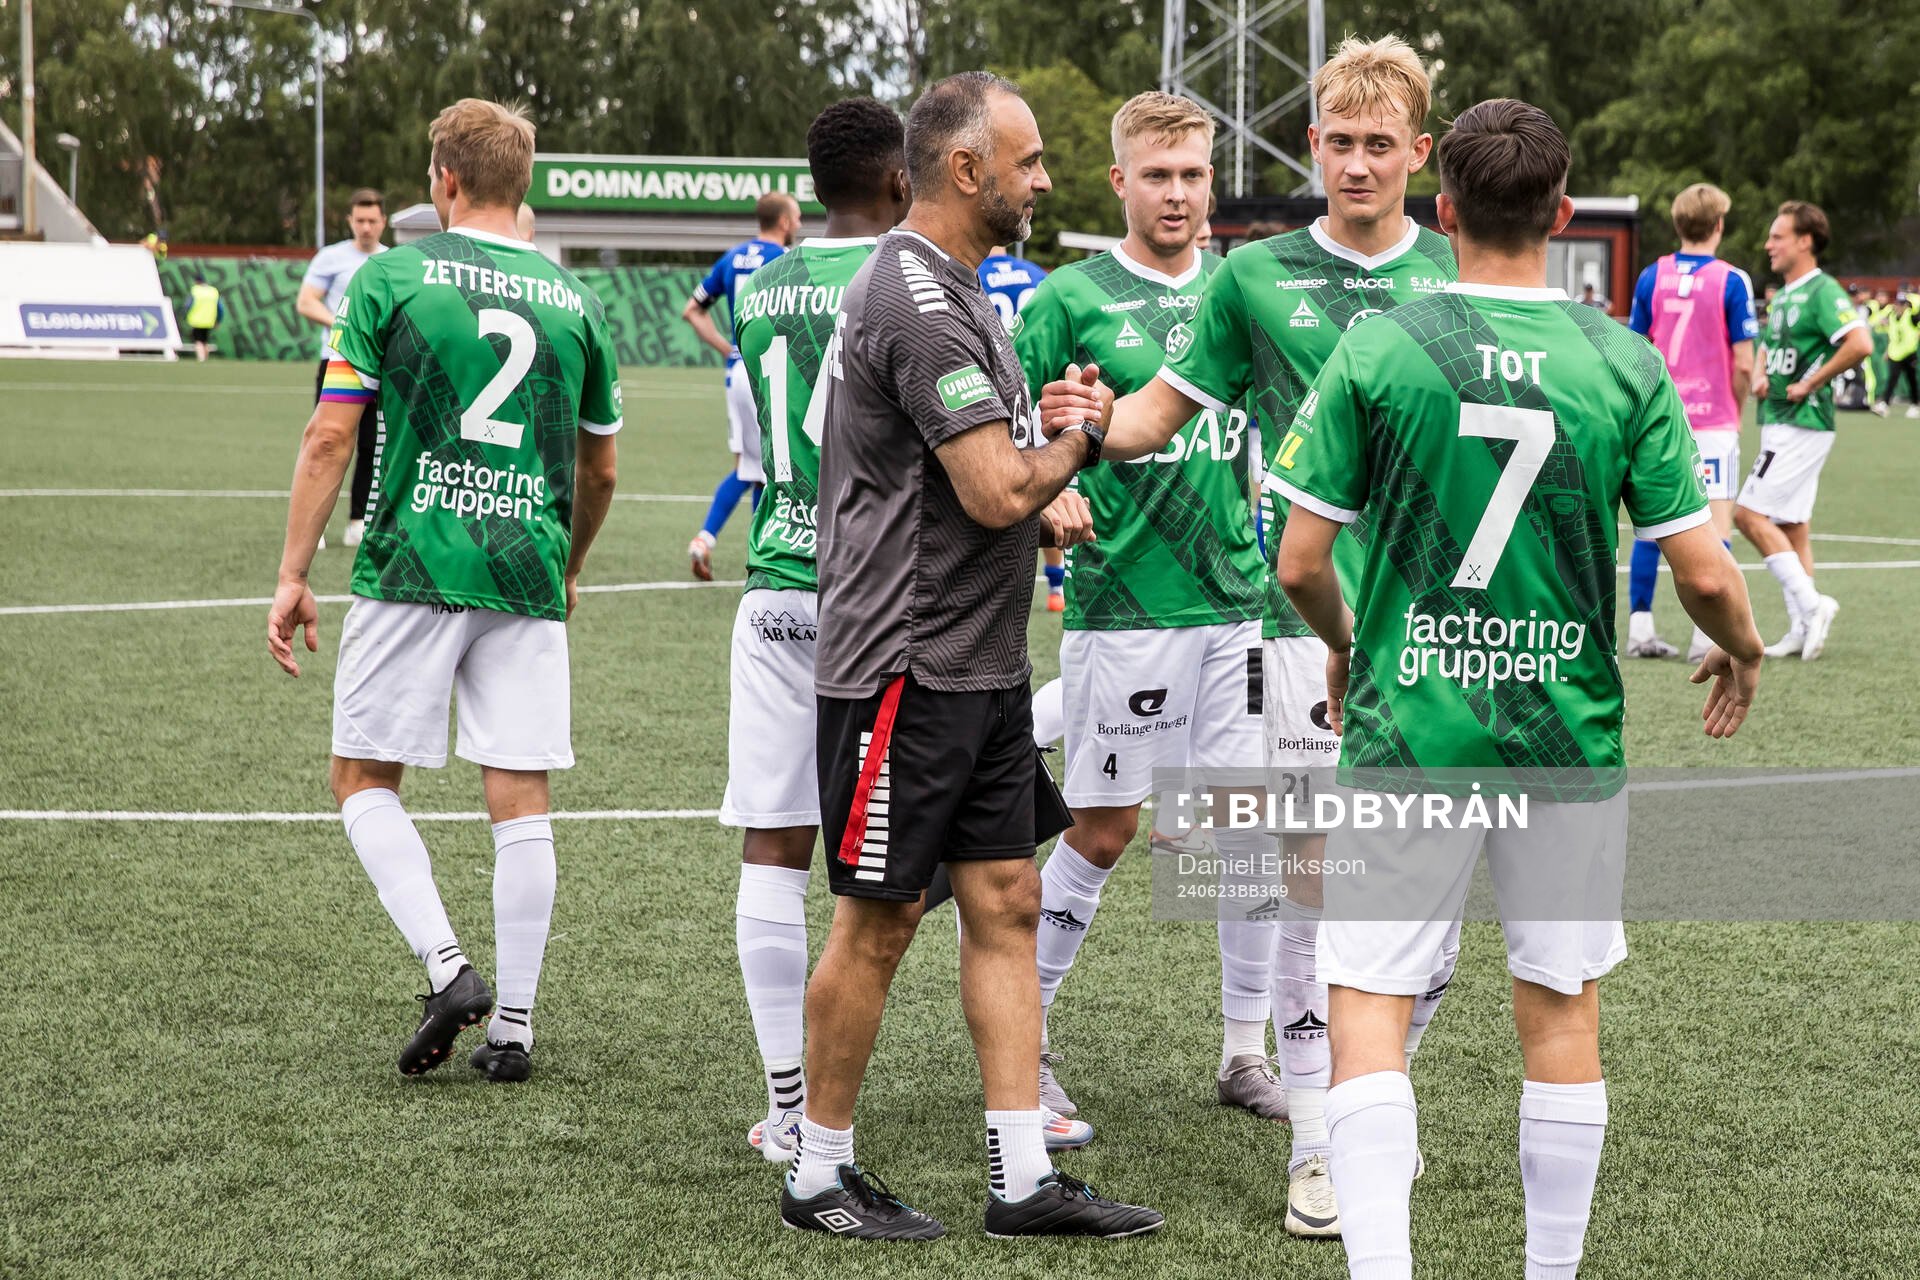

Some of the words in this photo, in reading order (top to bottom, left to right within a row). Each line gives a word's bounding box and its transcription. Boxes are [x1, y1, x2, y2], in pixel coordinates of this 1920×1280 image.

[547, 168, 820, 202] DOMNARVSVALLE
[422, 260, 585, 317] ZETTERSTRÖM
[1343, 278, 1396, 289] SACCI
[28, 311, 144, 331] ELGIGANTEN
[1289, 318, 1320, 328] SELECT
[1662, 300, 1695, 367] 7
[461, 308, 537, 449] 2
[1476, 344, 1547, 385] TOT
[943, 371, 992, 397] UNIBE
[1125, 408, 1248, 464] SAB
[415, 452, 545, 505] factoring
[1450, 402, 1556, 590] 7
[1403, 602, 1586, 660] factoring
[1097, 722, 1152, 737] Borlänge
[1154, 715, 1188, 731] Energi
[1278, 736, 1339, 753] Borlänge
[1102, 753, 1118, 781] 4
[1281, 772, 1311, 804] 21
[1283, 1031, 1325, 1040] SELEC
